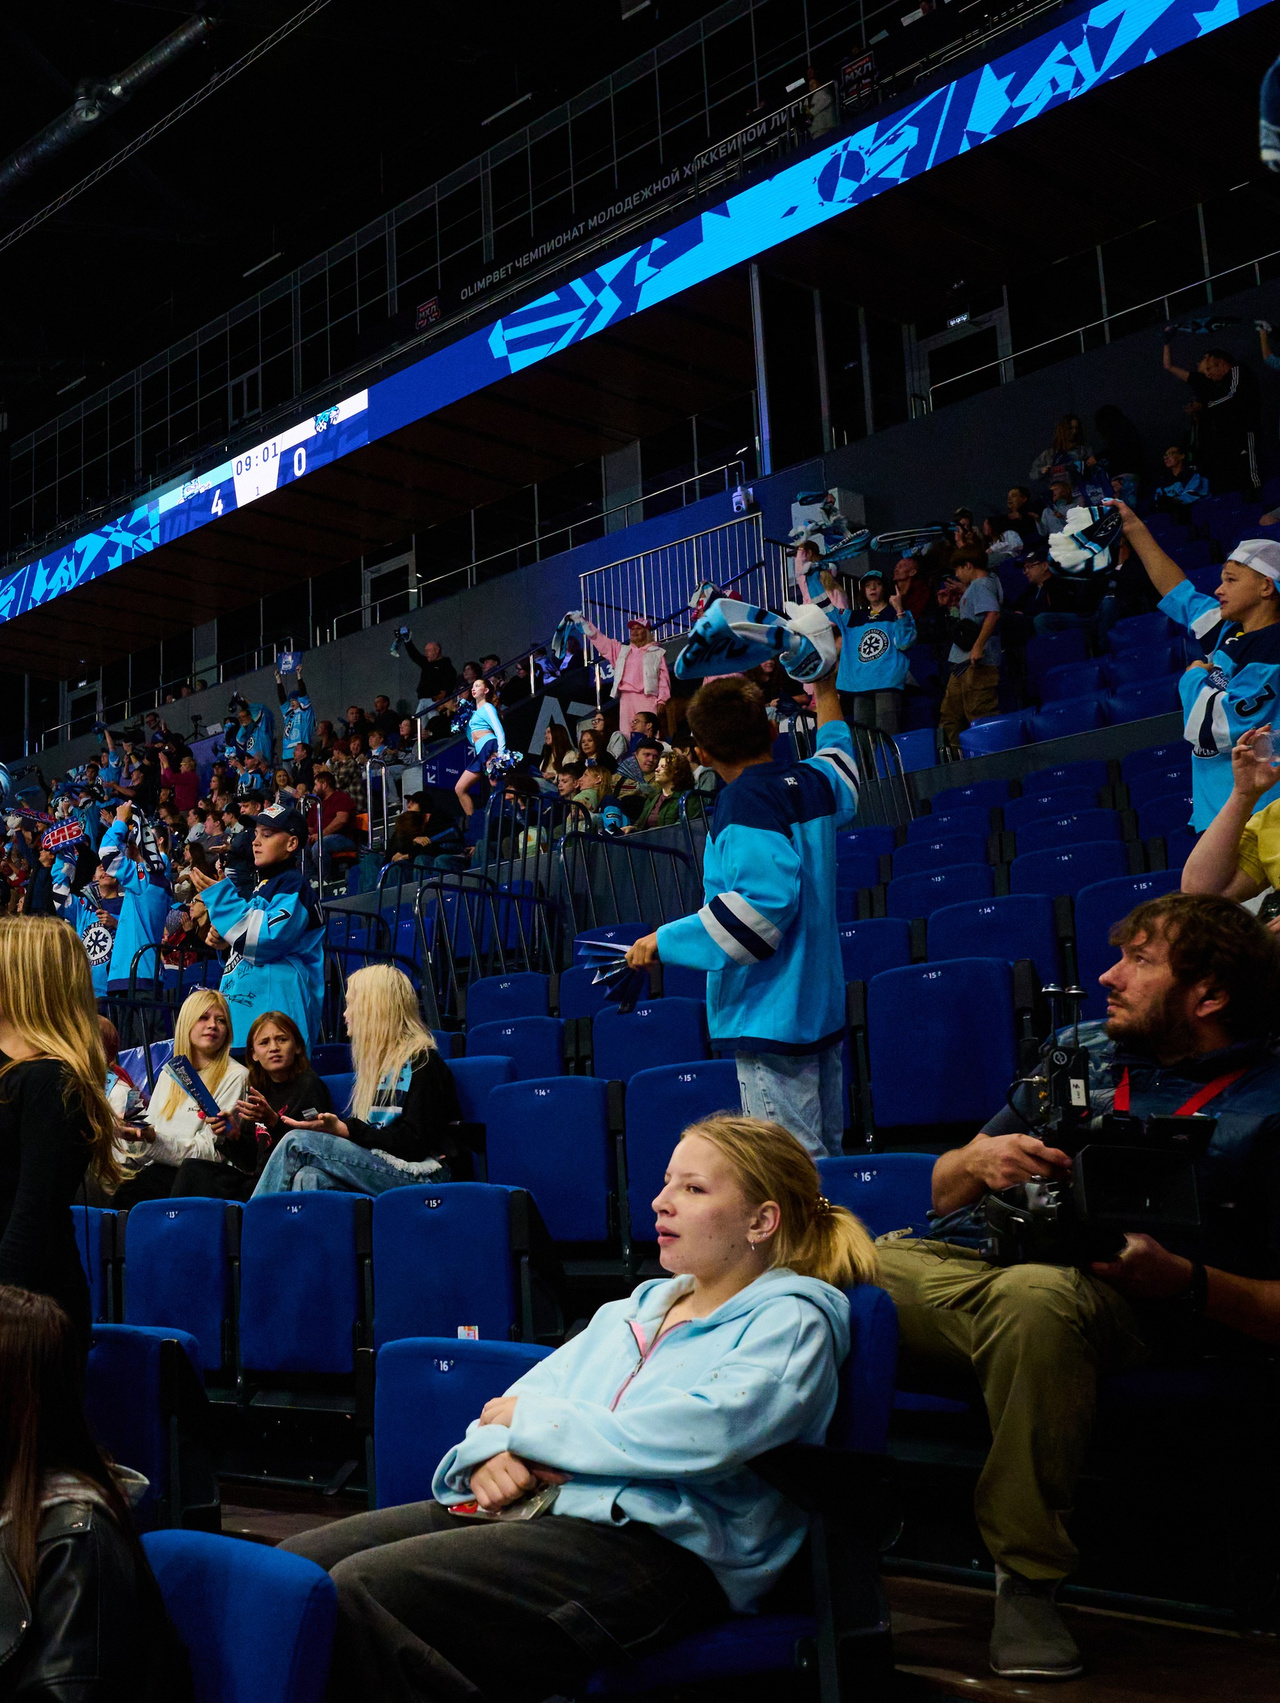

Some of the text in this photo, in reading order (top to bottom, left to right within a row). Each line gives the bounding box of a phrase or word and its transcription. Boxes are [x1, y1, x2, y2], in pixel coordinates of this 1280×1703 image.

[460, 262, 514, 301] OLIMPBET
[514, 222, 586, 268] ЧЕМПИОНАТ
[587, 168, 680, 230] МОЛОДЕЖНОЙ
[235, 442, 279, 476] 09:01
[293, 447, 307, 477] 0
[211, 489, 223, 516] 4
[1235, 682, 1277, 718] 3
[1139, 882, 1148, 890] 15
[928, 971, 937, 979] 15
[684, 1074, 692, 1082] 15
[861, 1171, 871, 1182] 16
[429, 1199, 437, 1208] 15
[291, 1206, 298, 1214] 14
[439, 1360, 449, 1372] 16
